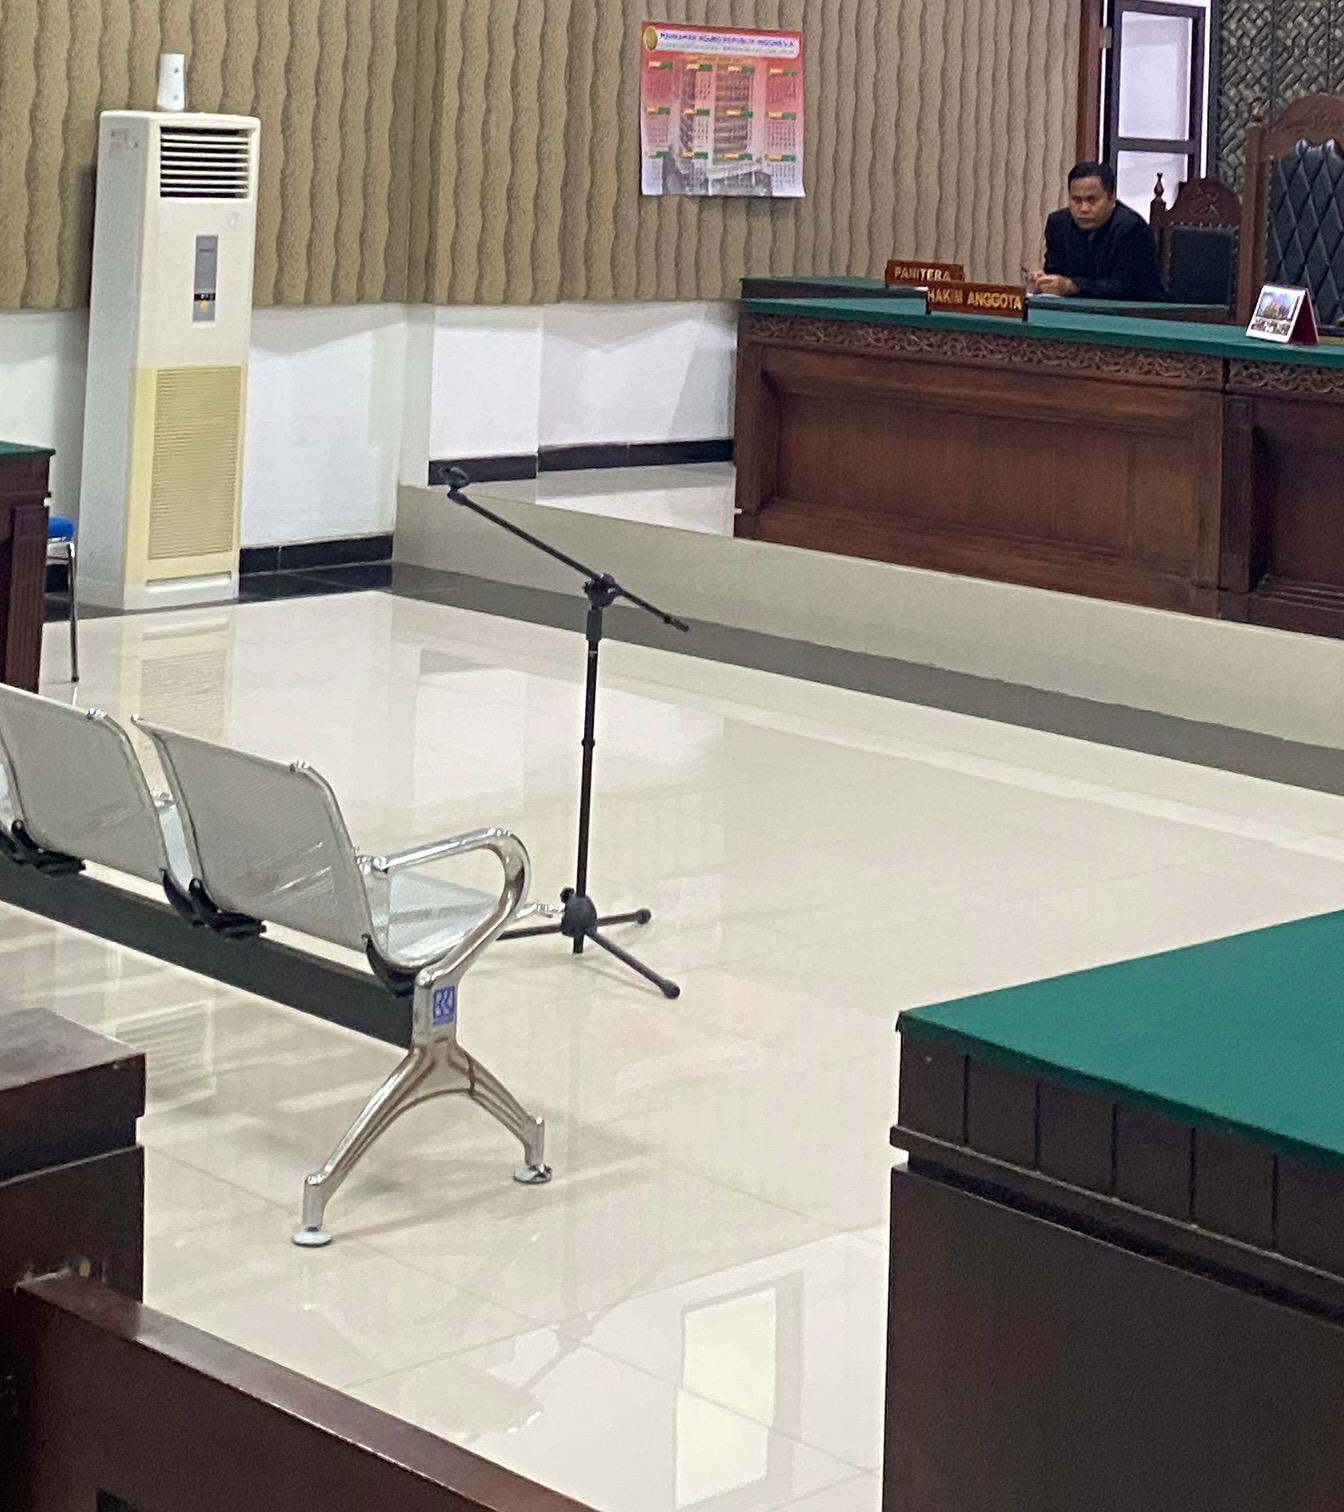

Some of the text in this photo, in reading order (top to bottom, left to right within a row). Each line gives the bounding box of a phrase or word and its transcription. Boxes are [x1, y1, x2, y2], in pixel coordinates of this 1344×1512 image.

[894, 266, 952, 281] PANITERA
[927, 289, 1022, 310] HAKIM ANGGOTA
